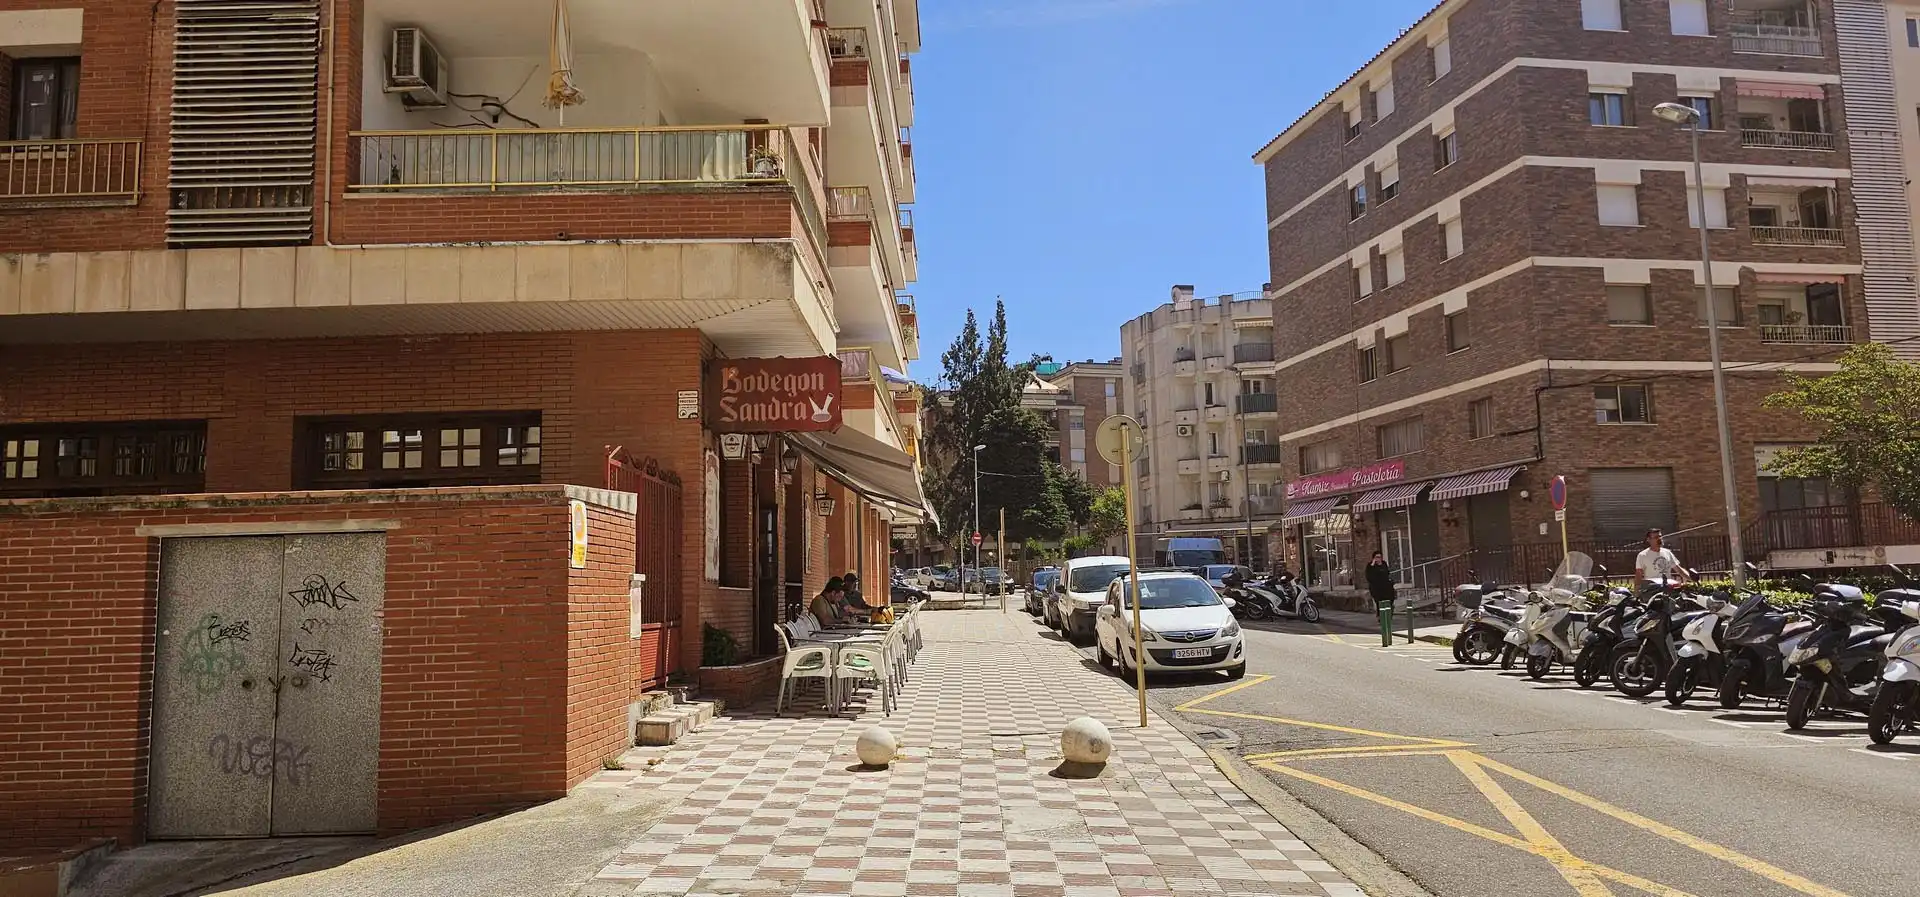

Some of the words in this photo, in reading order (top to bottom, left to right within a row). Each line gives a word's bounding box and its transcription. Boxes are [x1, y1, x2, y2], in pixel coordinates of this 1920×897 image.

[721, 366, 825, 397] Bodegon
[719, 396, 807, 423] Sandra
[1352, 464, 1400, 486] Pastelería
[1176, 650, 1195, 658] 3256
